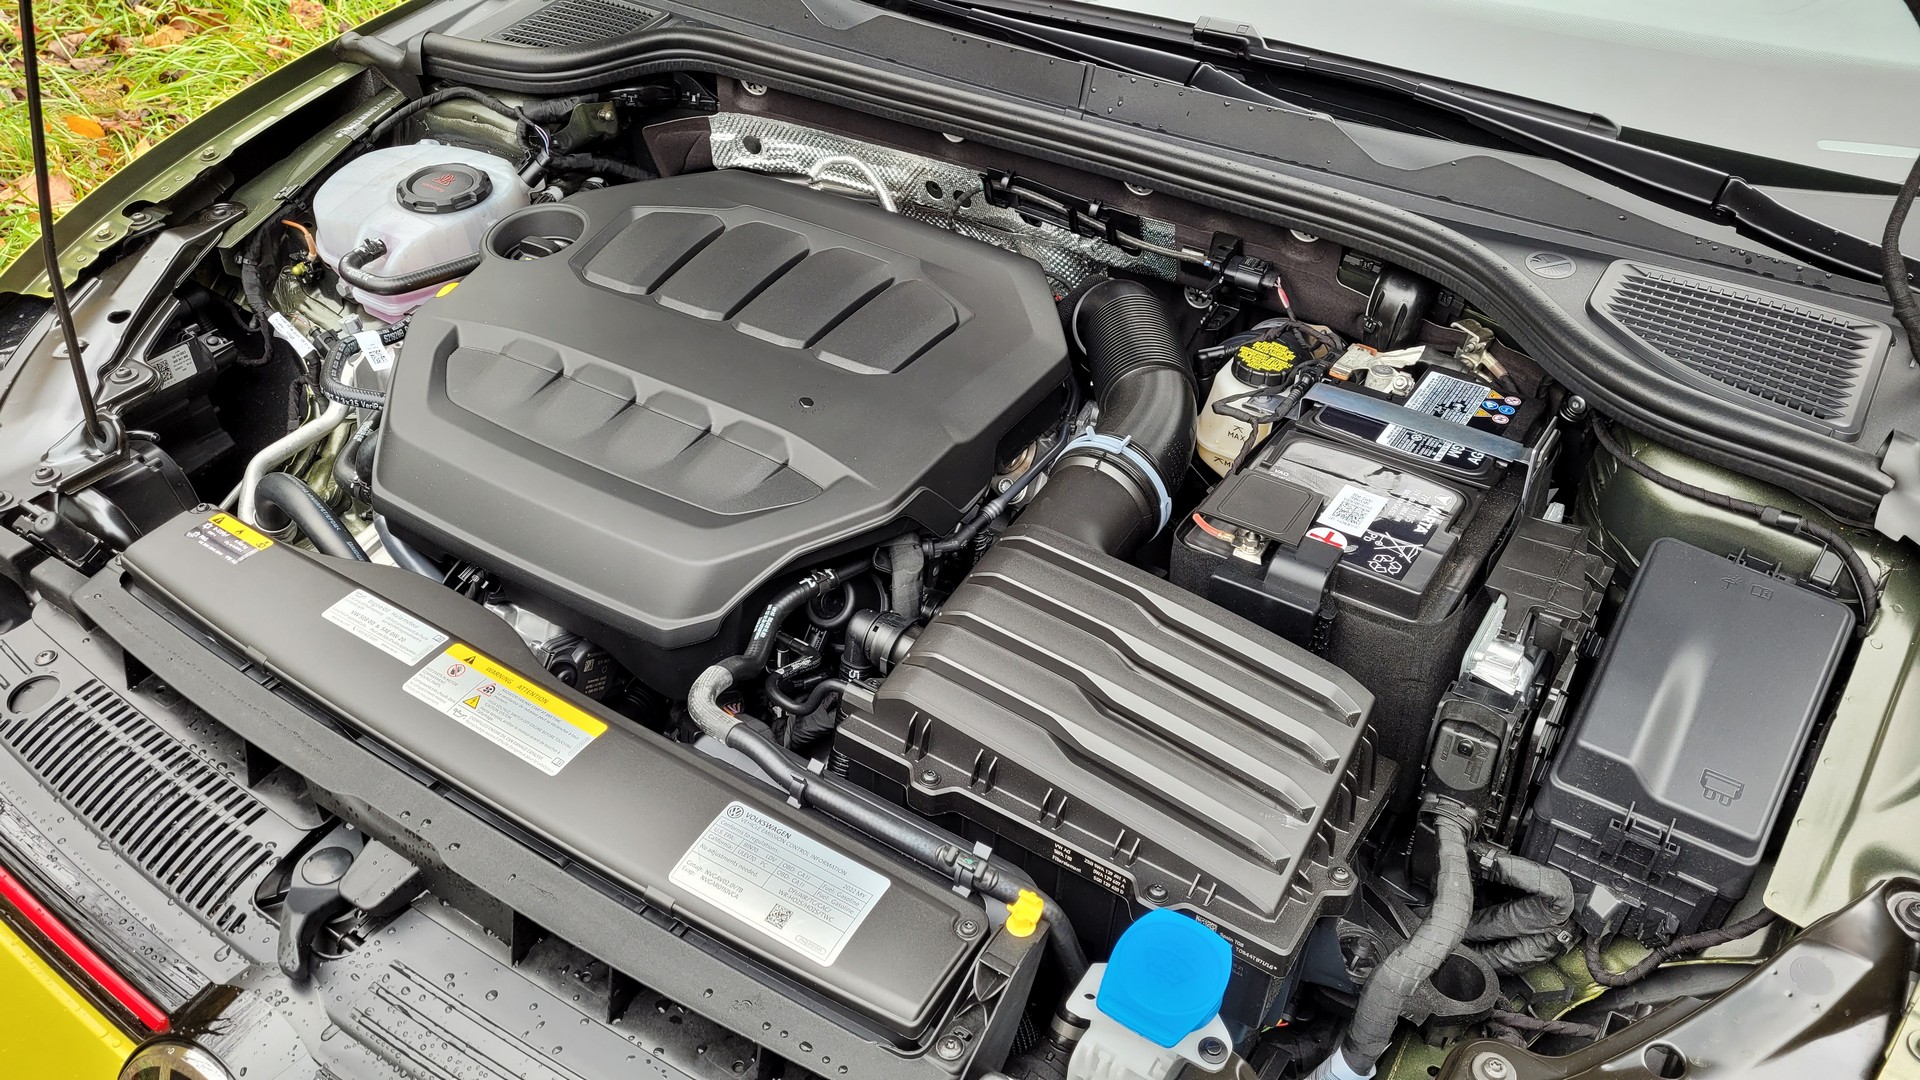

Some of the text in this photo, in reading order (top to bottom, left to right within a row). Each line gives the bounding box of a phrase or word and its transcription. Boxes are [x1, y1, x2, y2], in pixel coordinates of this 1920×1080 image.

[1227, 431, 1246, 442] MAX
[1447, 444, 1466, 459] GM
[1467, 452, 1485, 465] AG
[1413, 505, 1442, 534] VARTA
[1363, 531, 1378, 542] Pb
[484, 666, 549, 704] WARNING ATTENTION
[719, 820, 744, 835] Conforms
[744, 811, 792, 839] VOLKSWAGEN
[705, 847, 739, 868] adjustments
[739, 817, 848, 876] VEHICLE EMISSION CONTROL INFORMATION
[736, 848, 757, 862] ULEV70
[758, 860, 768, 868] PC
[790, 877, 800, 885] CA
[829, 898, 855, 914] Gasoline
[742, 842, 759, 853] BIN70
[765, 853, 777, 862] LDV
[796, 870, 806, 878] CA
[835, 890, 861, 907] Gasoline
[787, 886, 832, 913] DFI/AIR/TC/CAC/
[842, 883, 866, 899] 2022 MY
